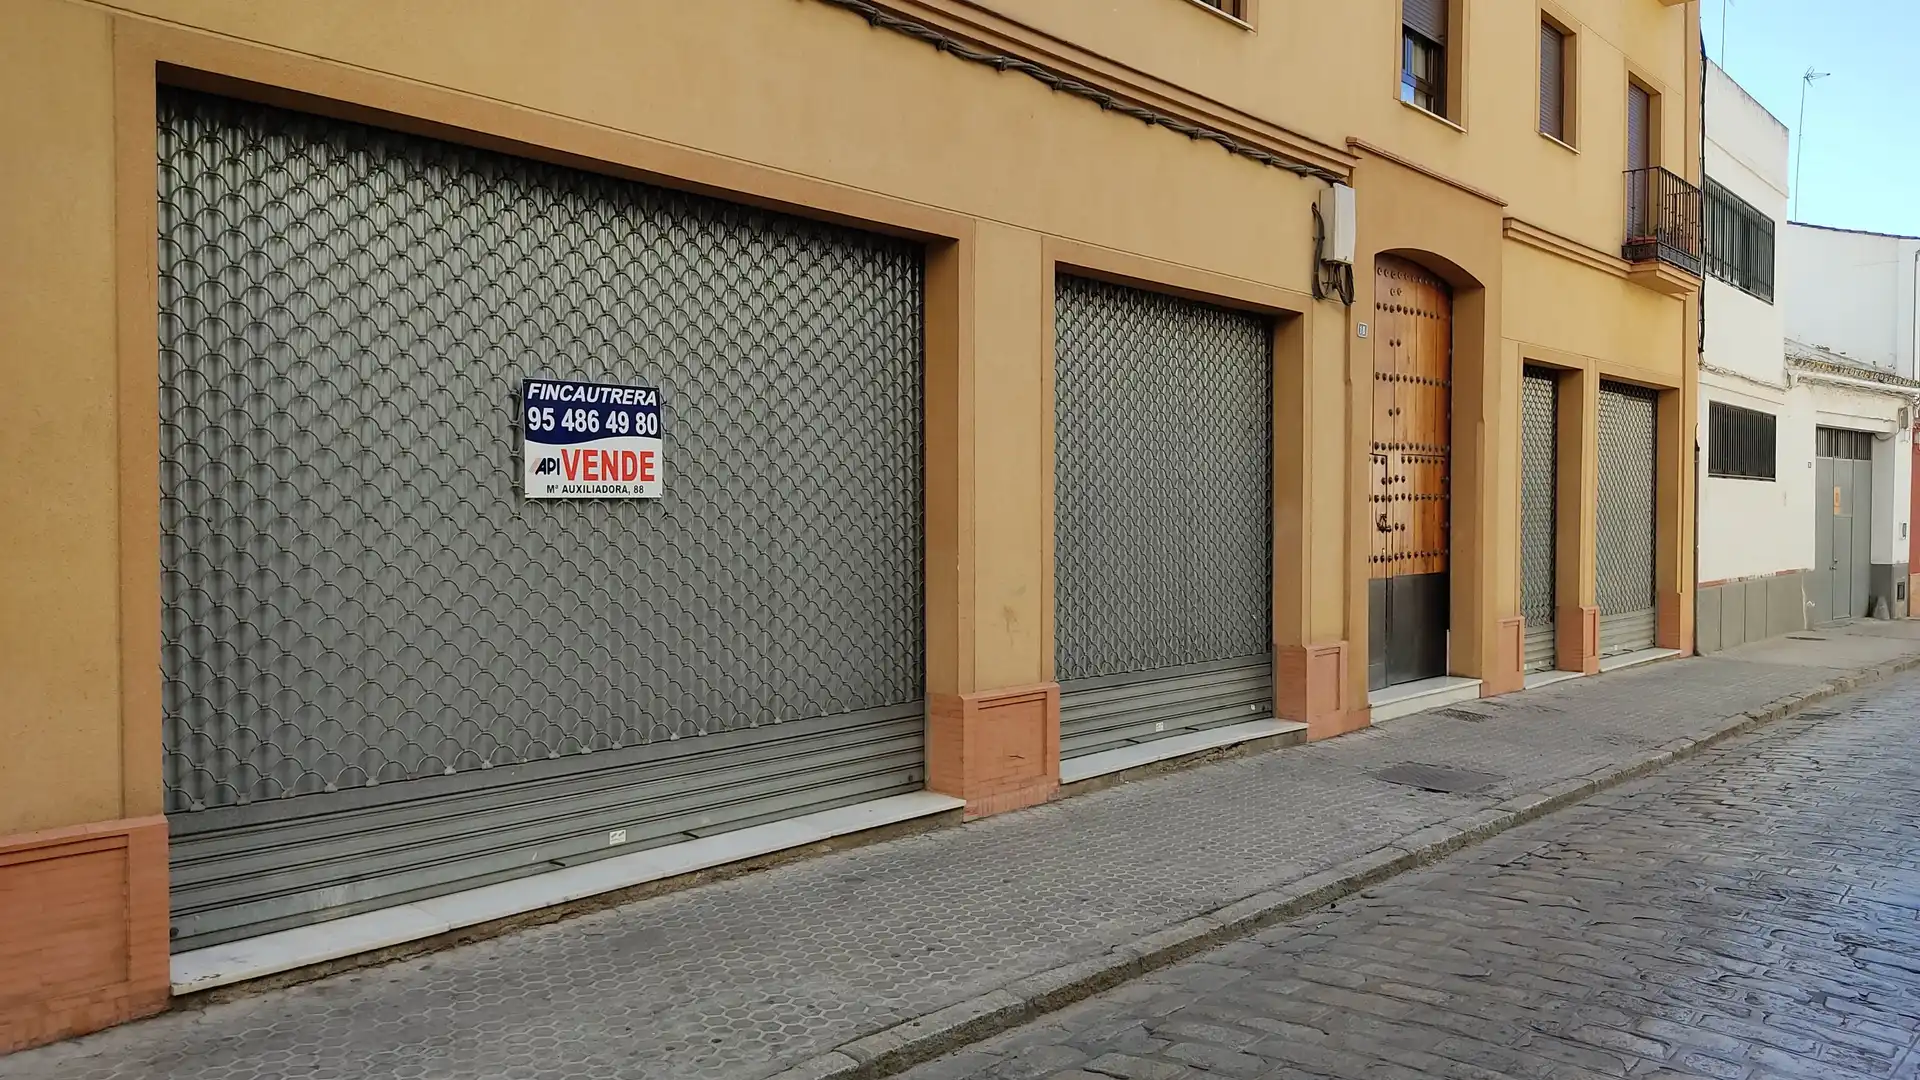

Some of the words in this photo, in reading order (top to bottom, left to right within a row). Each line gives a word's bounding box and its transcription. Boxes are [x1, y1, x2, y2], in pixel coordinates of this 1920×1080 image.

[527, 383, 657, 406] FINCAUTRERA
[528, 406, 555, 431] 95
[561, 408, 600, 433] 486
[605, 411, 630, 434] 49
[635, 412, 658, 435] 80
[535, 457, 560, 475] API
[561, 449, 655, 481] VENDE
[562, 485, 631, 495] AUXILIADORA,
[633, 485, 644, 494] 88
